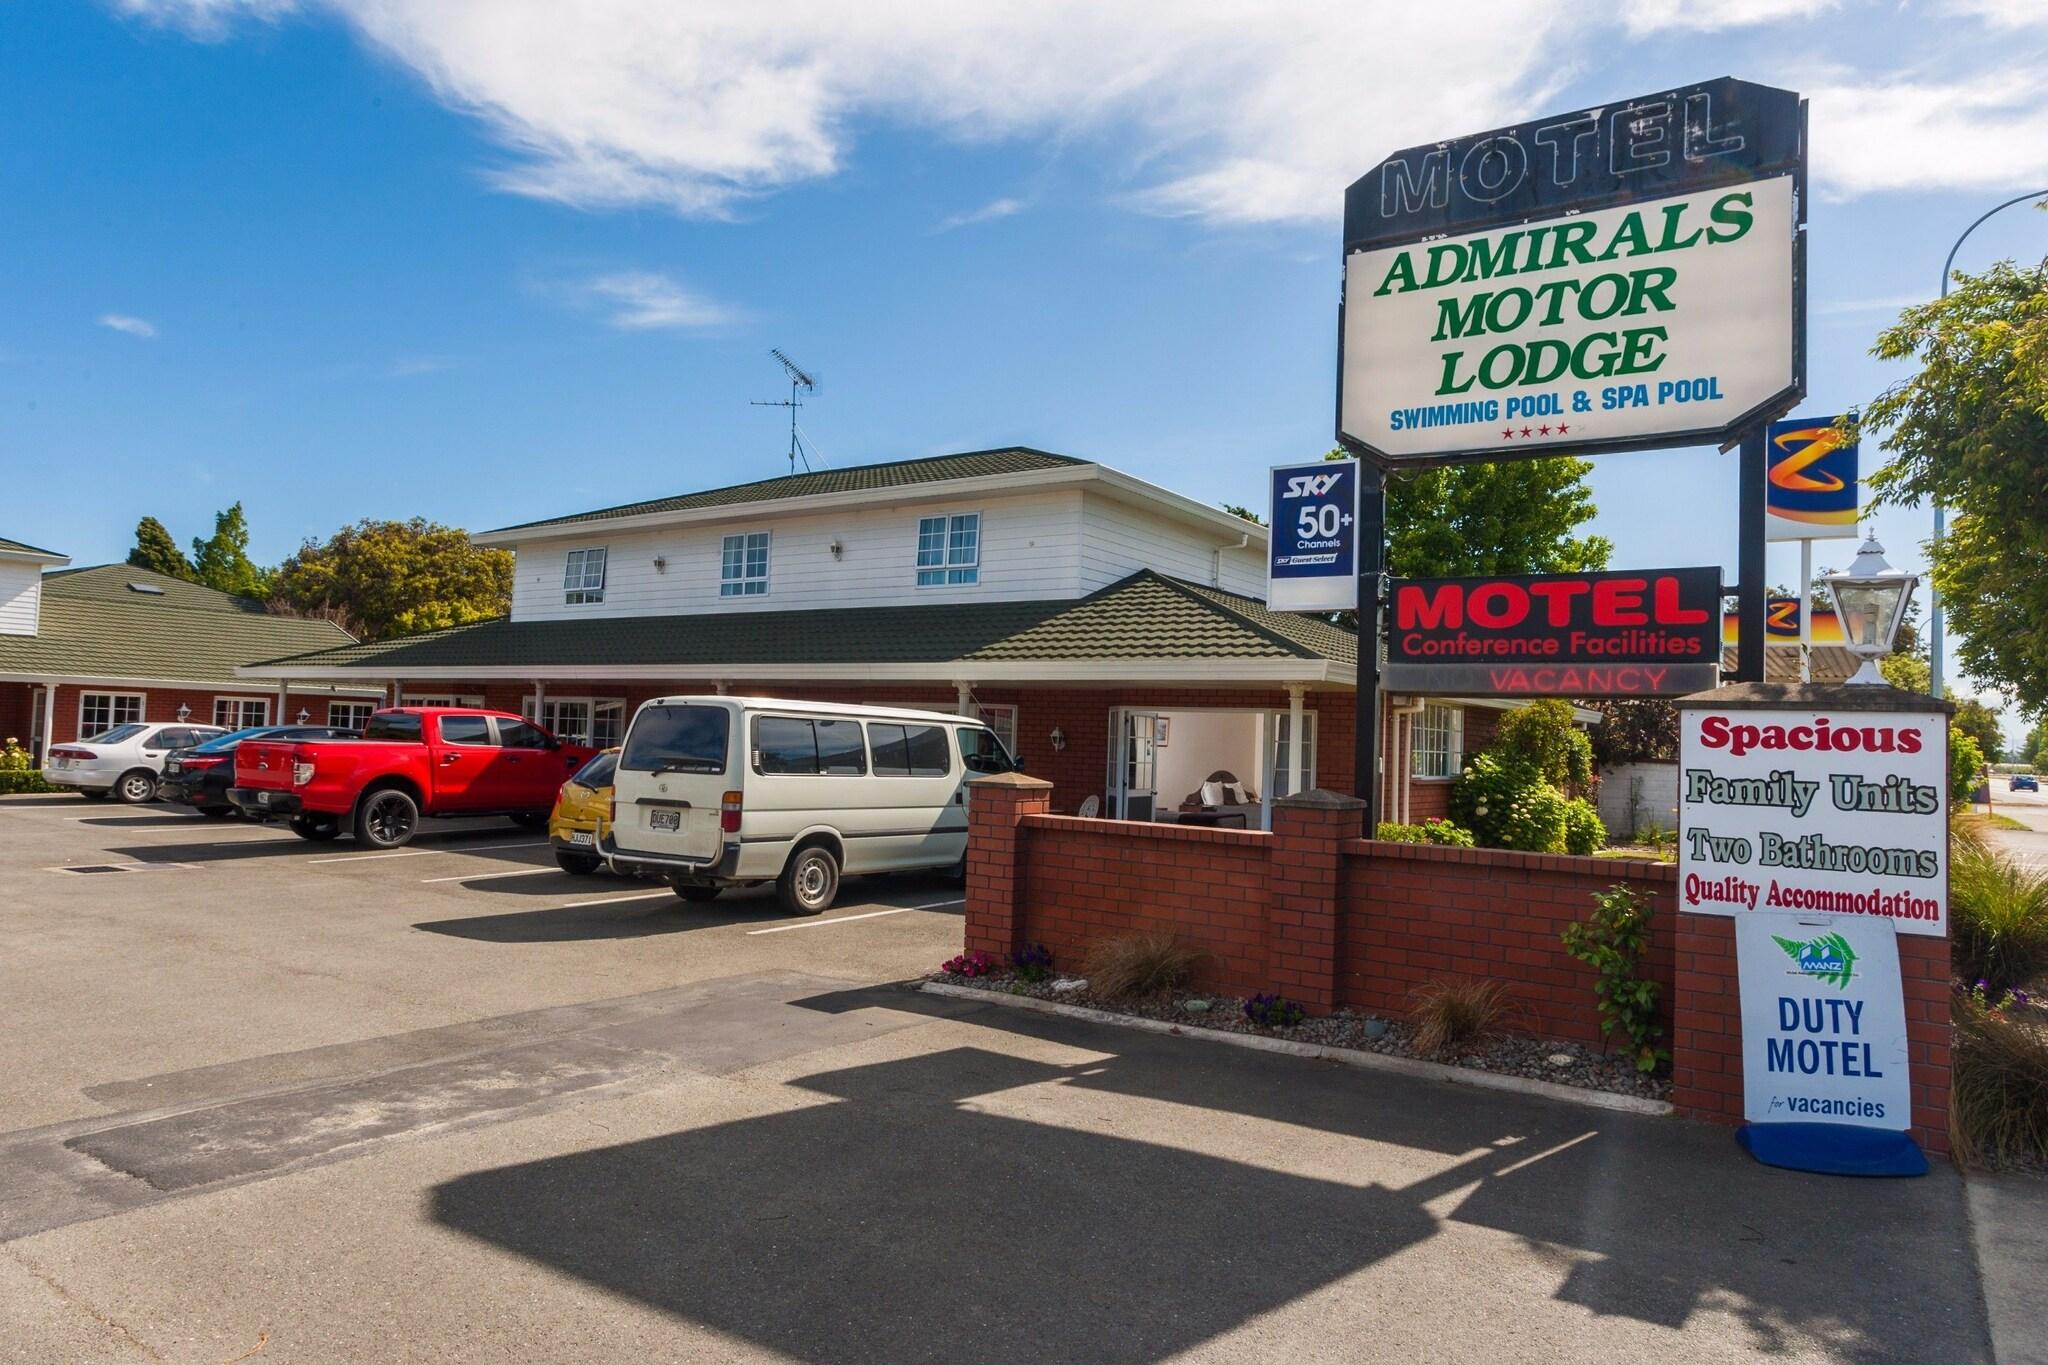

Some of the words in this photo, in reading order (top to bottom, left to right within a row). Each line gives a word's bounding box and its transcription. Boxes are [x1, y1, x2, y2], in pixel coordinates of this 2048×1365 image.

[1381, 92, 1745, 218] MOTEL
[1373, 191, 1754, 296] ADMIRALS
[1431, 266, 1678, 342] MOTOR
[1435, 326, 1669, 396] LODGE
[1390, 399, 1498, 431] SWIMMING
[1506, 394, 1564, 420] POOL
[1572, 391, 1592, 412] &
[1602, 385, 1649, 409] SPA
[1658, 377, 1723, 403] POOL
[1282, 472, 1344, 499] SKY
[1297, 503, 1353, 539] 50+
[1297, 538, 1341, 550] Channels
[1397, 576, 1709, 630] MOTEL
[1402, 632, 1560, 656] Conference
[1570, 629, 1701, 655] Facilities
[1489, 667, 1668, 692] VACANCY
[1700, 716, 1922, 757] Spacious
[1686, 769, 1819, 818] Family
[1829, 774, 1939, 815] Units
[1687, 827, 1752, 864] Two
[1759, 831, 1939, 879] Bathrooms
[1685, 872, 1760, 911] Quality
[1765, 879, 1940, 921] Accommodation
[1802, 960, 1842, 971] MANZ
[1778, 997, 1864, 1035] DUTY
[1767, 1038, 1883, 1078] MOTEL
[1768, 1096, 1785, 1114] for
[1787, 1096, 1885, 1118] vacancies
